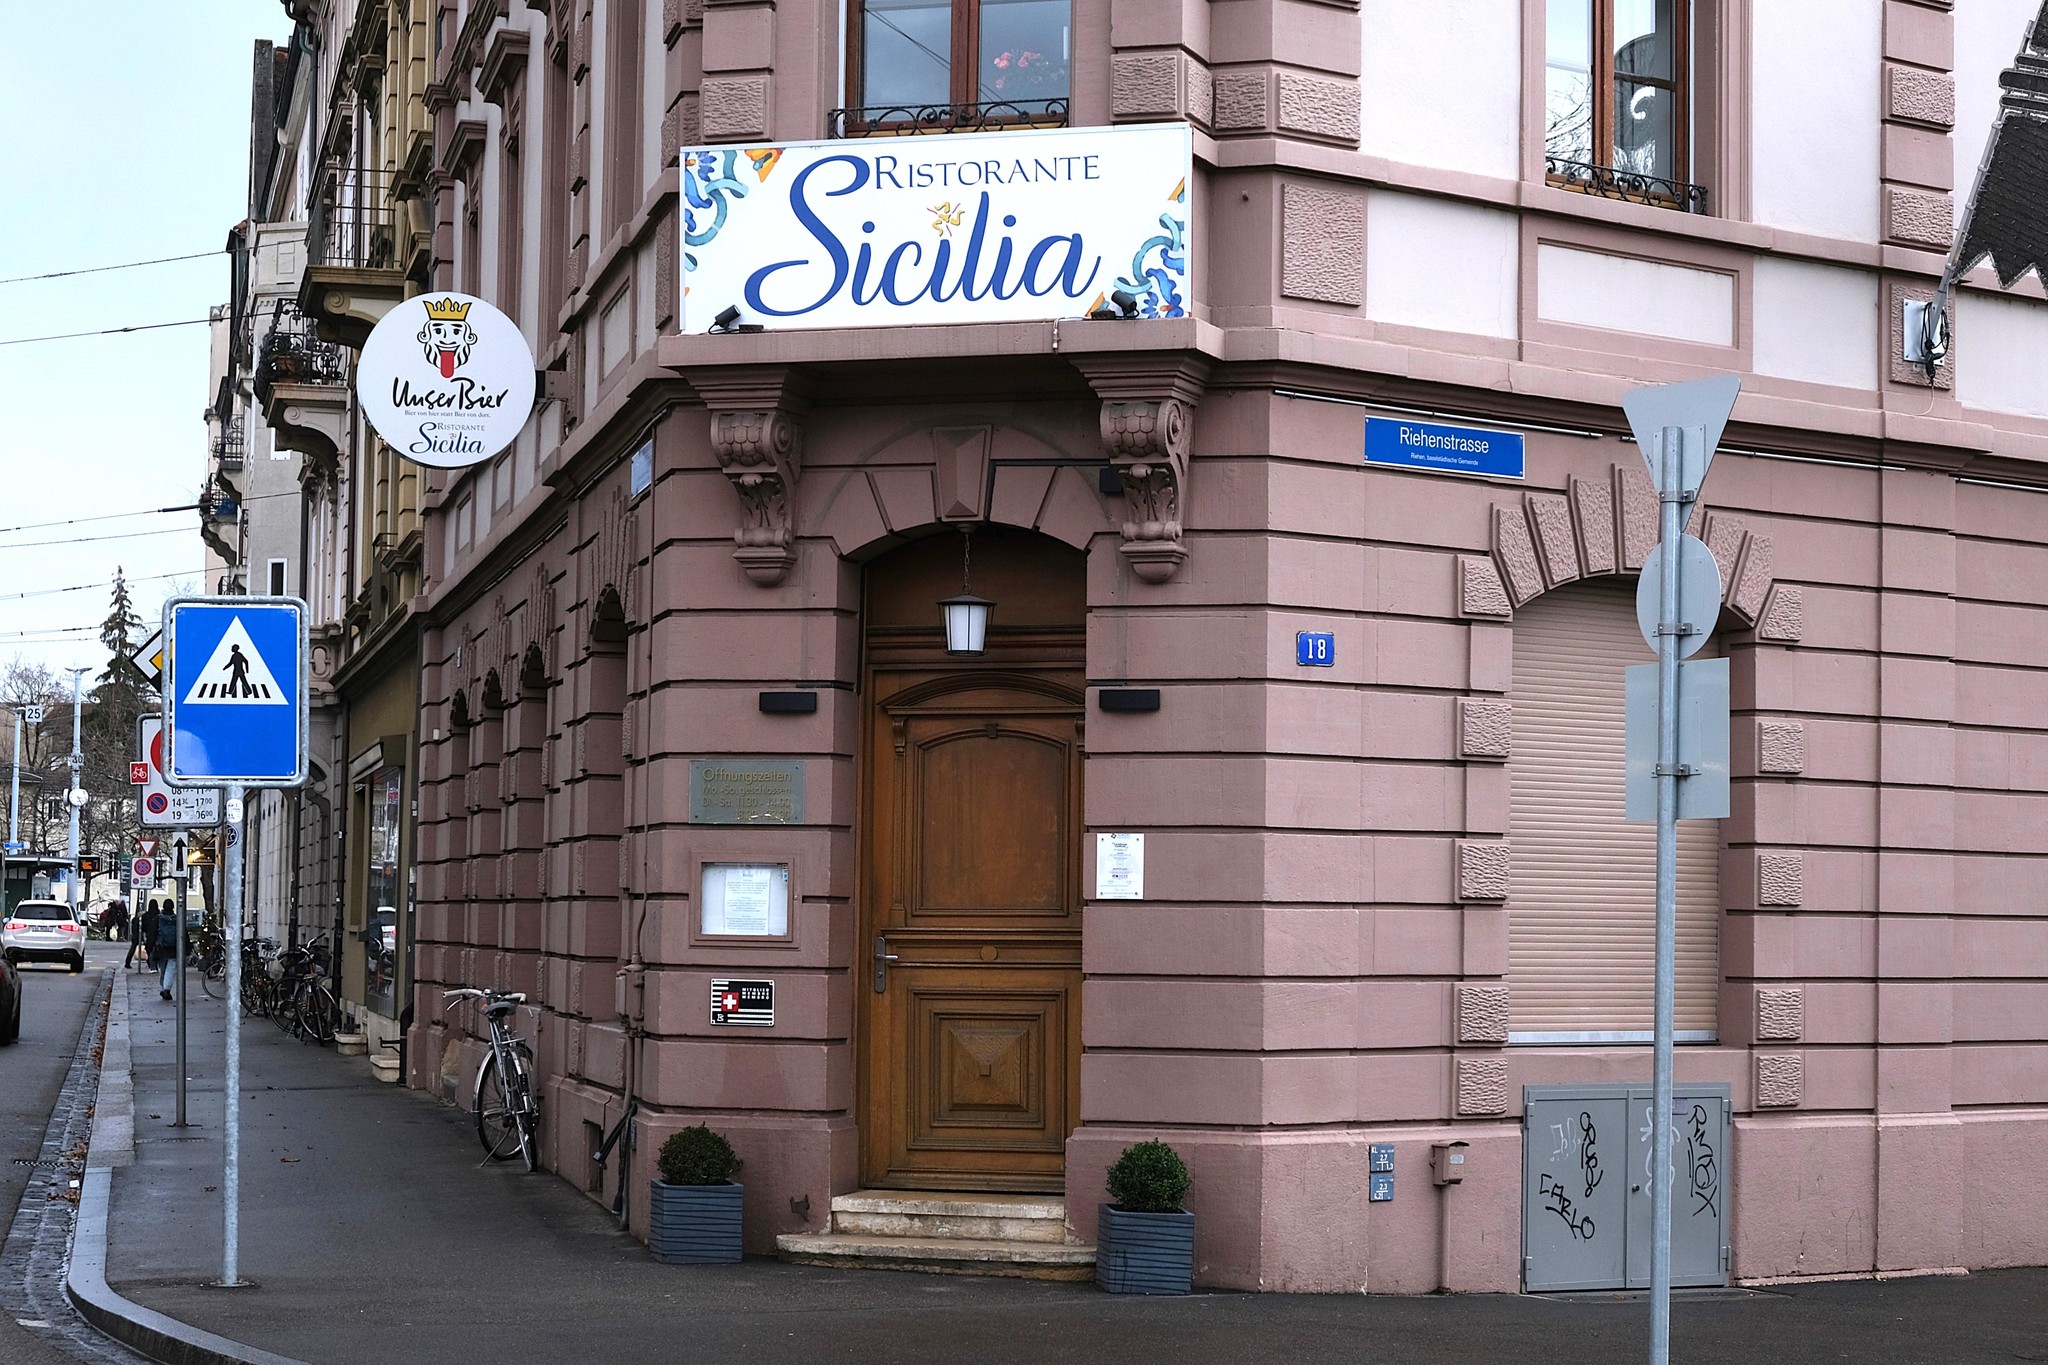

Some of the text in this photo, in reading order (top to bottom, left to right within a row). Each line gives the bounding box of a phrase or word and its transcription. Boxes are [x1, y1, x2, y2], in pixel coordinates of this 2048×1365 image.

[874, 154, 1100, 190] RISTORANTE
[744, 154, 1101, 316] Sicilia
[392, 376, 509, 410] Unser Bier
[409, 421, 486, 454] Sicilia
[437, 421, 486, 432] RISTORANTE
[1400, 426, 1490, 454] Riehenstrasse
[1410, 452, 1426, 461] Riehen,
[1457, 457, 1479, 466] Gemeinde
[1308, 638, 1326, 660] 18
[27, 708, 41, 720] 25
[738, 783, 793, 797] geschlossen
